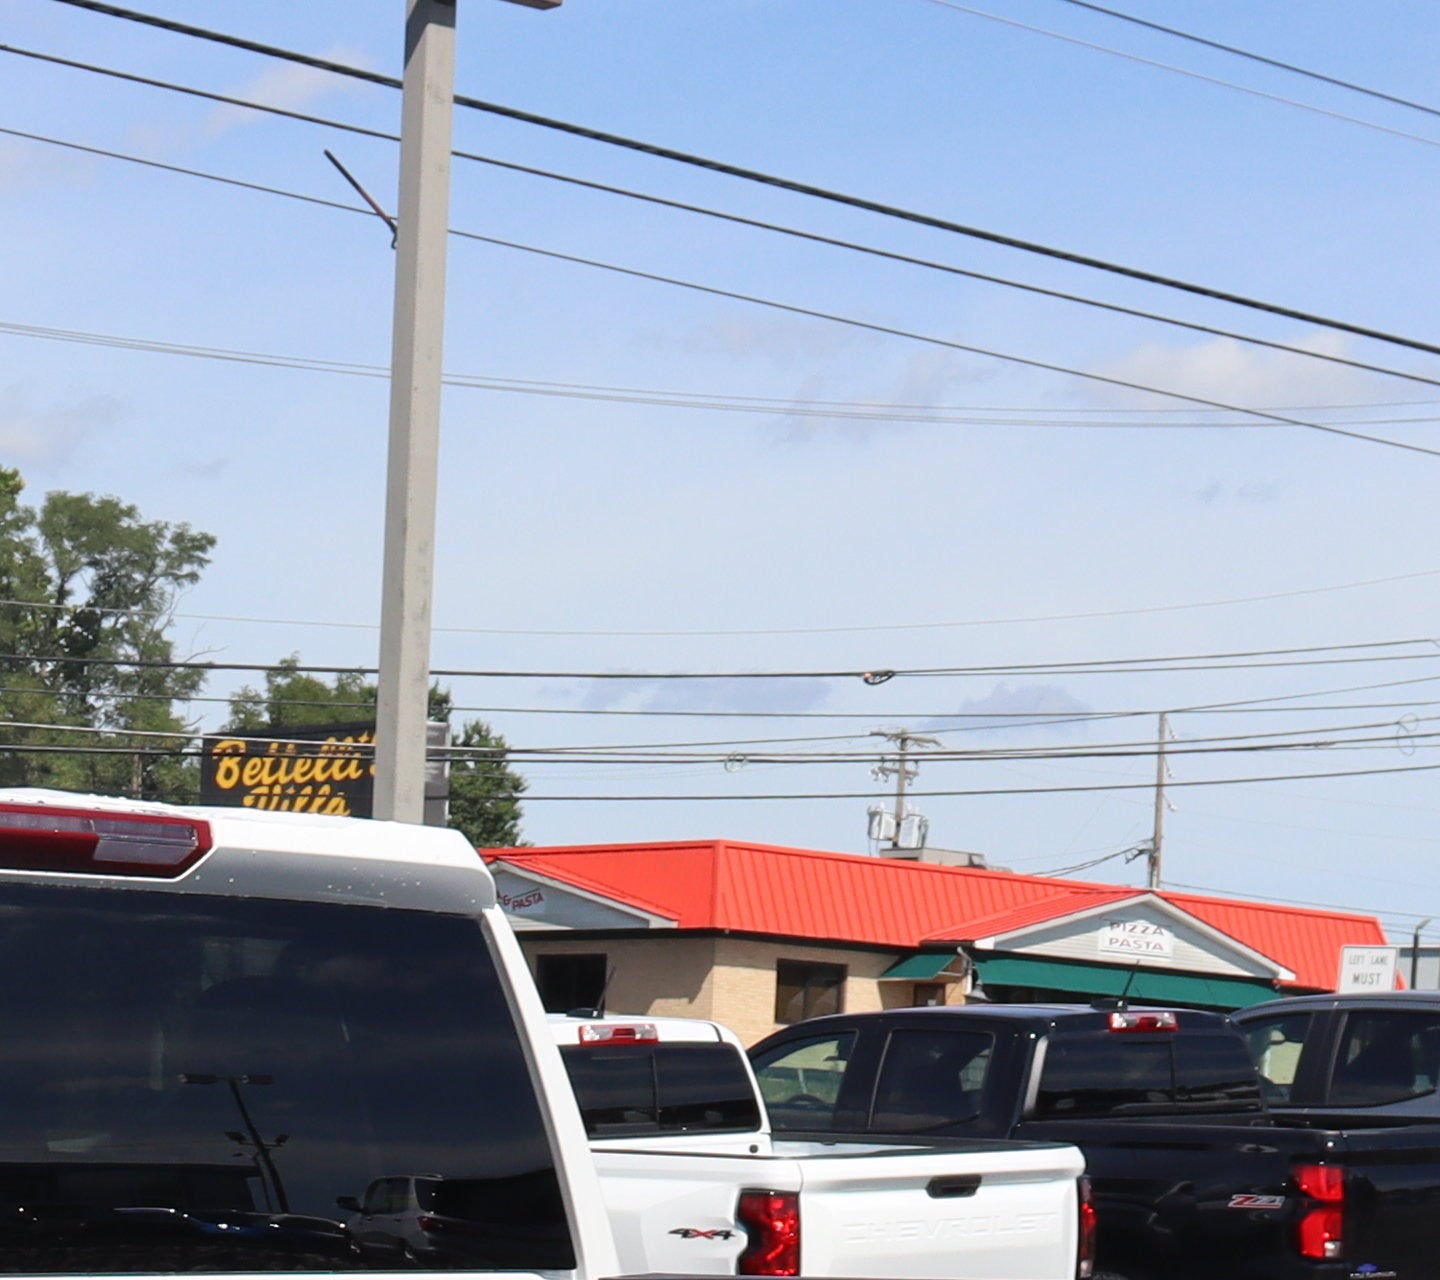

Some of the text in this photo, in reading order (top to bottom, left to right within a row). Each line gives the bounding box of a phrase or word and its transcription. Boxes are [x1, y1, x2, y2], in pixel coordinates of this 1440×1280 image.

[512, 892, 544, 912] PASTA
[1110, 921, 1164, 936] PIZZA
[1109, 937, 1164, 951] PASTA
[1352, 972, 1382, 986] MUST
[841, 1212, 1060, 1244] CHEVROLET
